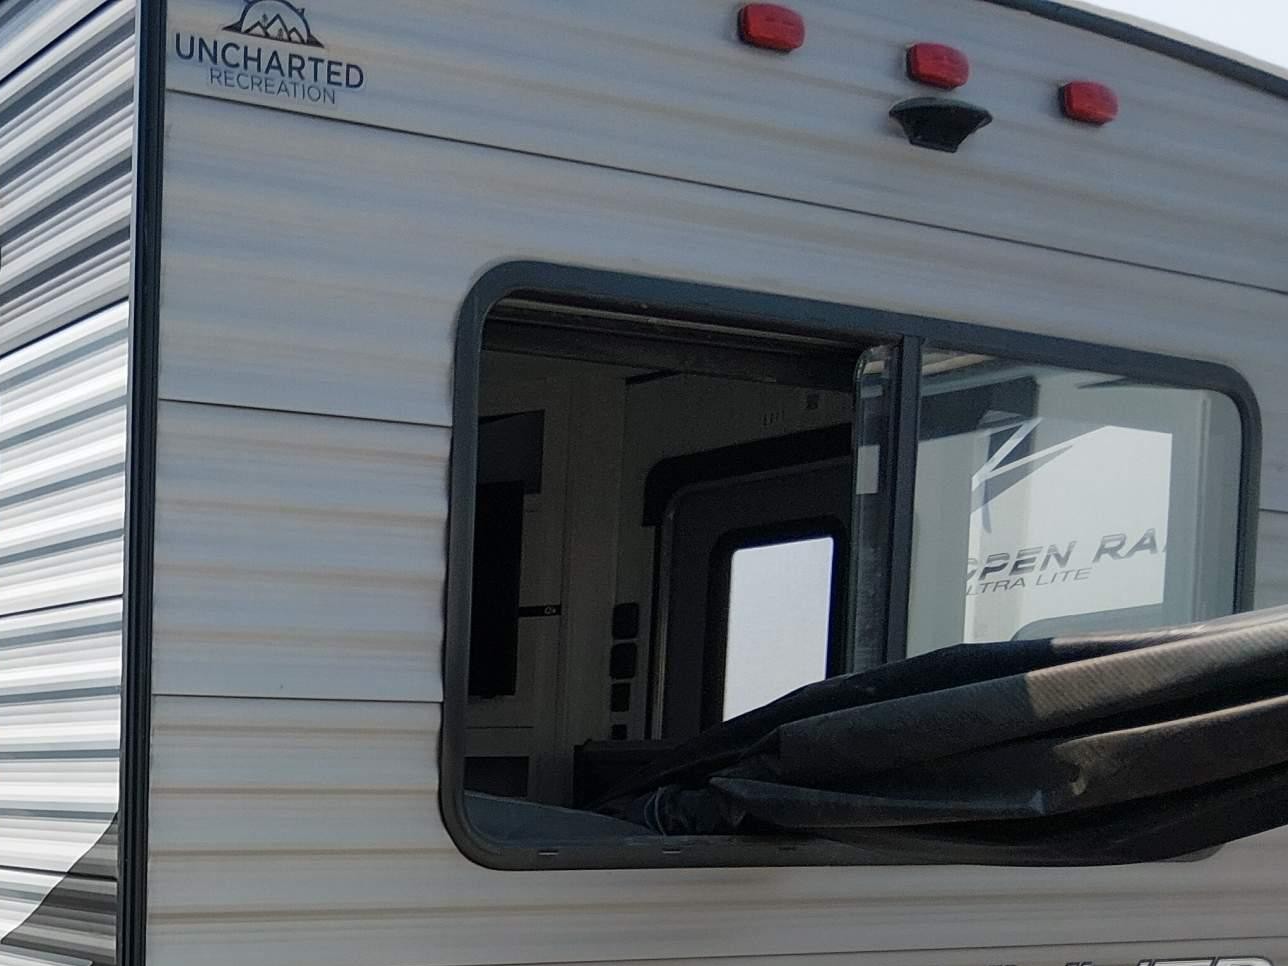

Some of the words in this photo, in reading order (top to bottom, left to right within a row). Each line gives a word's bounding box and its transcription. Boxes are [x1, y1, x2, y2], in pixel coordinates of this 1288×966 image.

[175, 32, 364, 89] UNCHARTED
[210, 67, 336, 105] RECREATION
[1035, 567, 1093, 587] LITE
